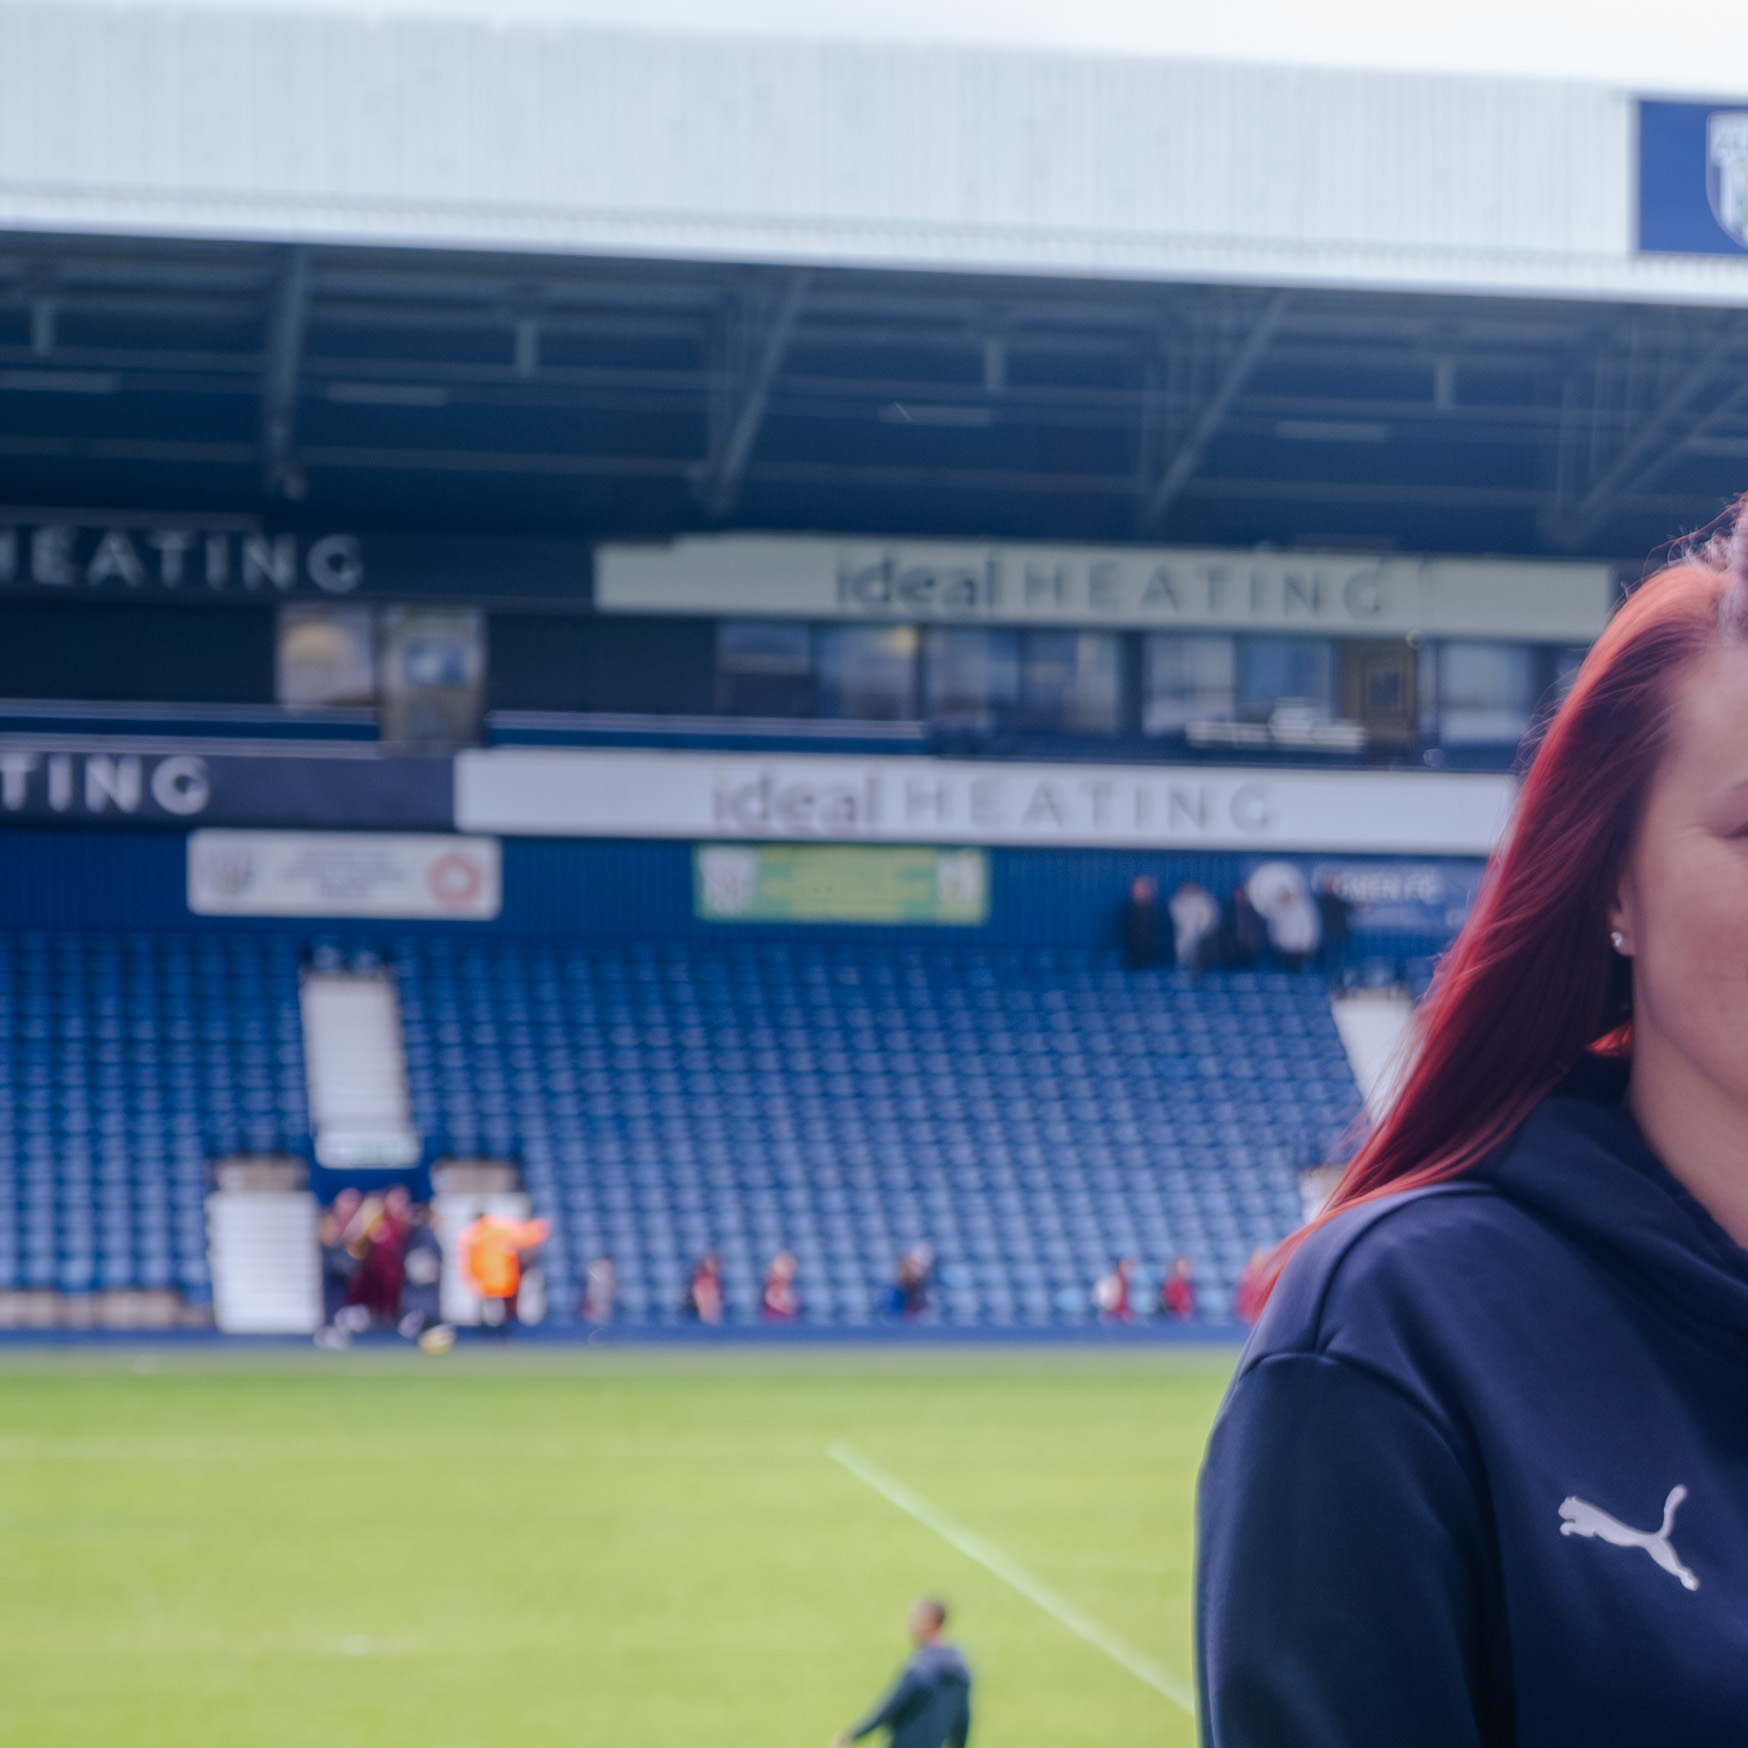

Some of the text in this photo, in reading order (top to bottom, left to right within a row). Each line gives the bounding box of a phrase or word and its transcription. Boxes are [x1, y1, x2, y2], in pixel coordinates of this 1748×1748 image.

[0, 524, 364, 594] EATING
[836, 548, 1390, 620] ideal HEATING
[710, 764, 1282, 836] ideal HEATING
